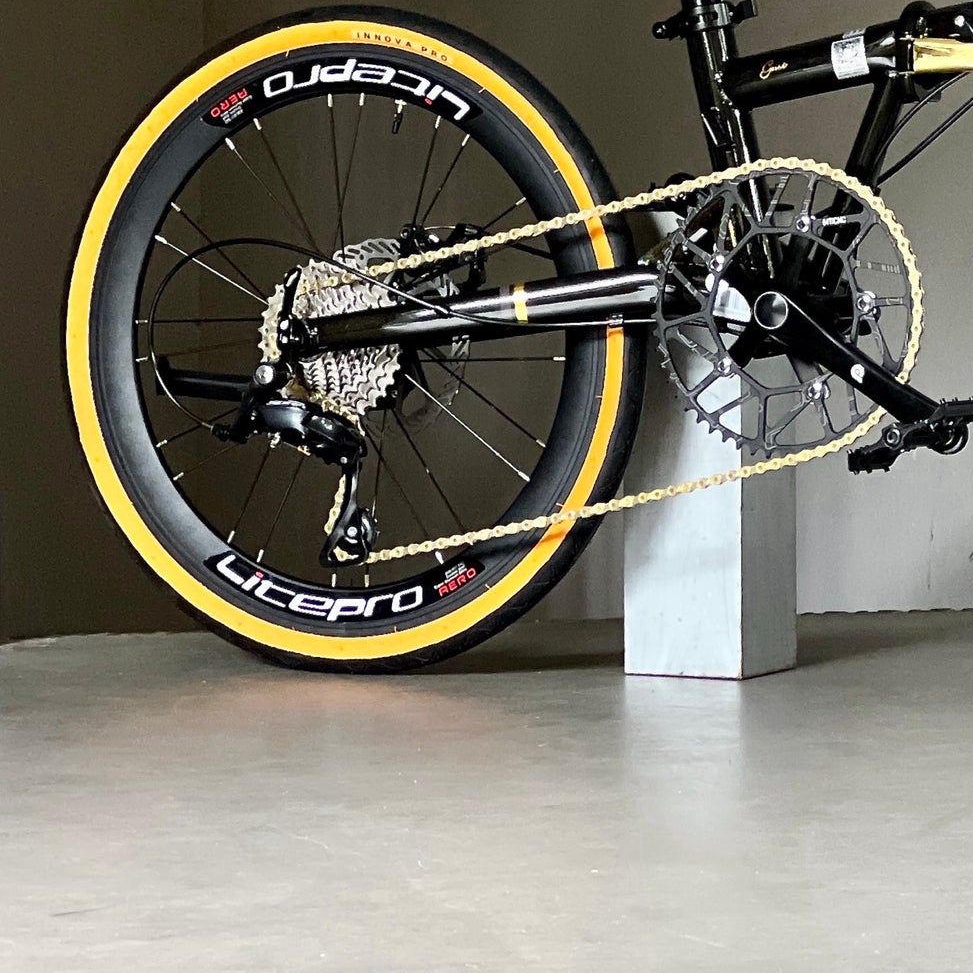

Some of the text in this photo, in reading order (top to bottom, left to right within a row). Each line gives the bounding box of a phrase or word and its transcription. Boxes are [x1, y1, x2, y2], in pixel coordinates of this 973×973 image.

[356, 32, 448, 62] INNOVA PRO
[210, 87, 249, 118] AERO
[263, 58, 471, 121] Litepro
[216, 554, 424, 622] Litepro
[438, 567, 477, 597] AERO
